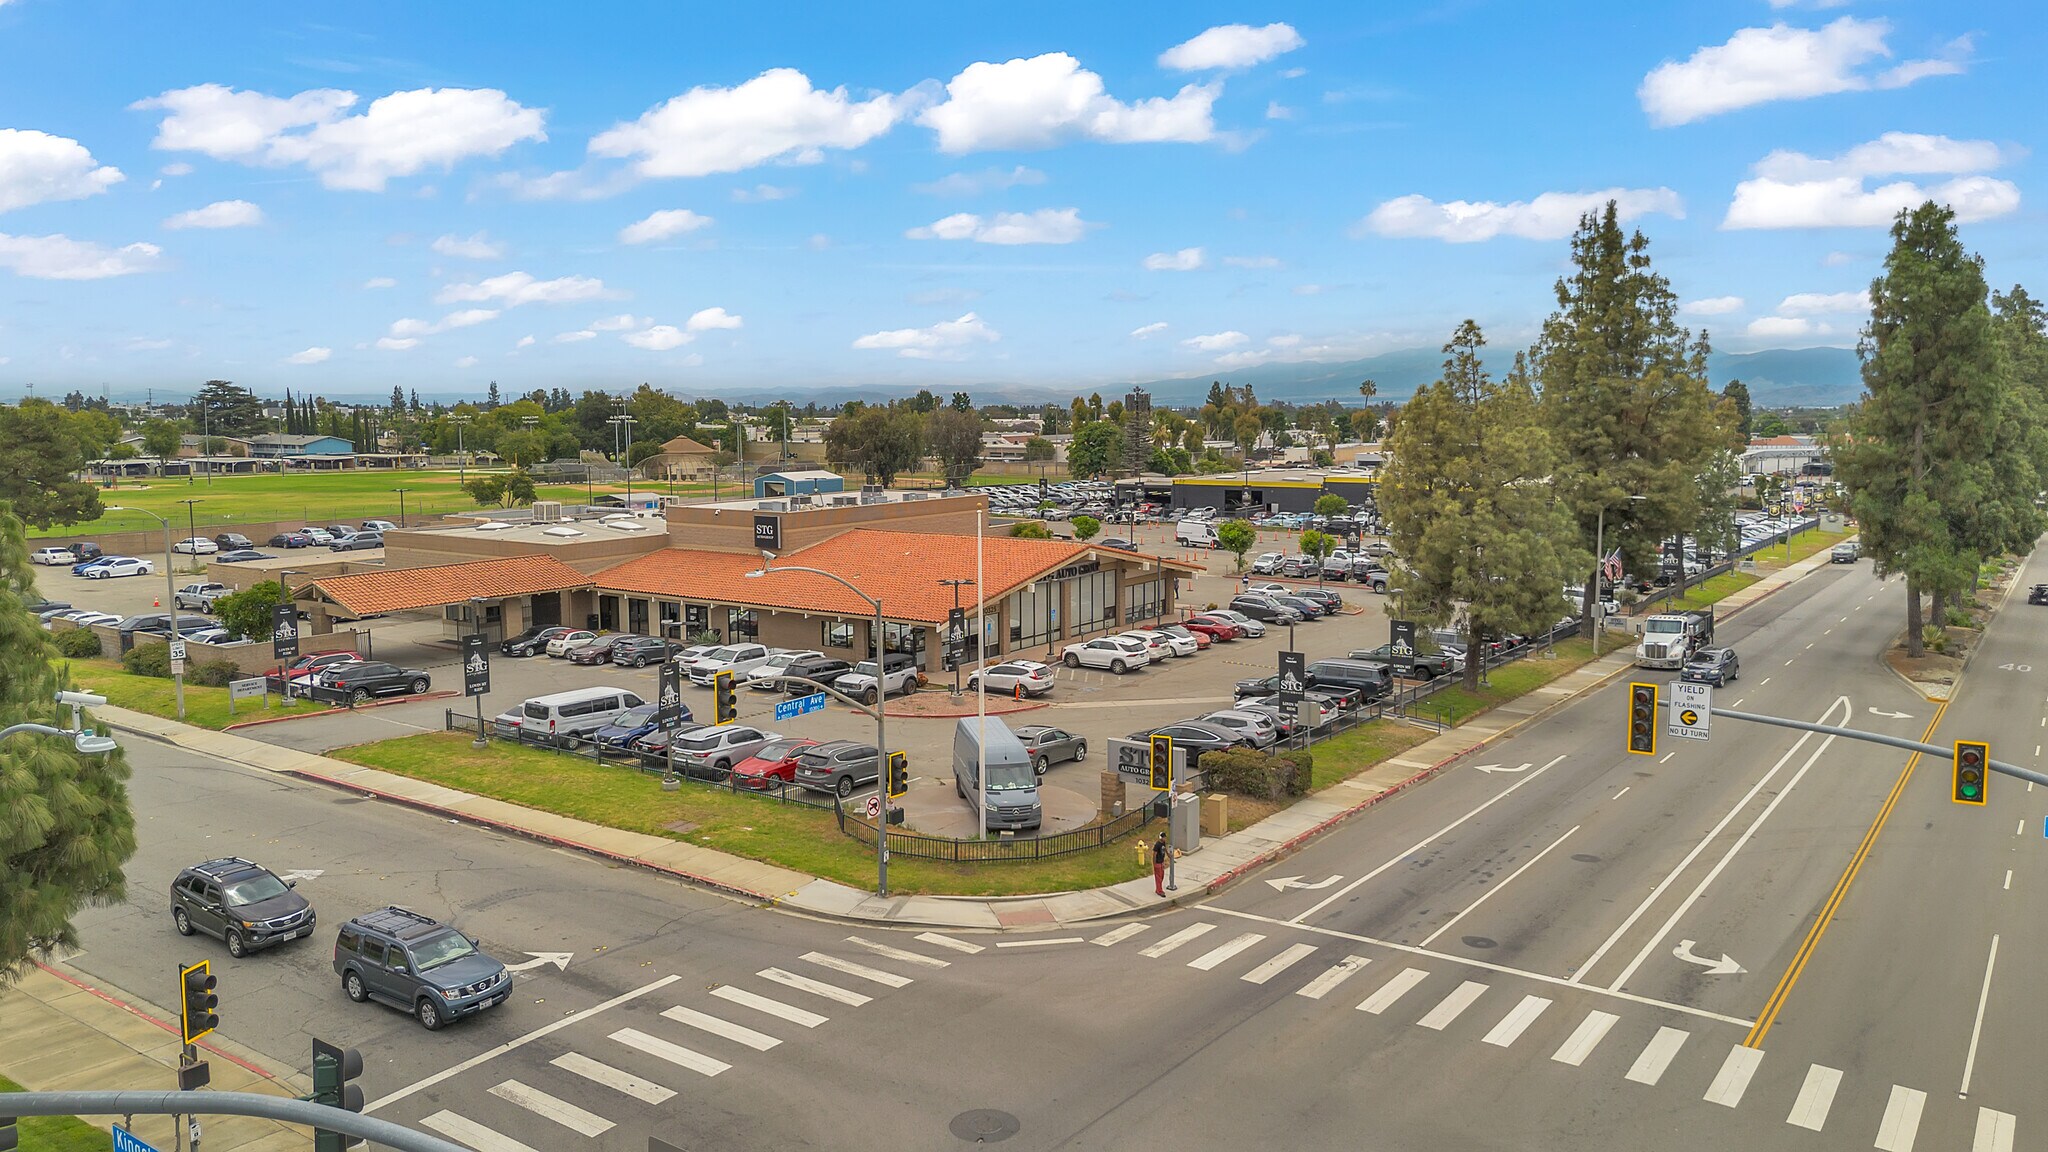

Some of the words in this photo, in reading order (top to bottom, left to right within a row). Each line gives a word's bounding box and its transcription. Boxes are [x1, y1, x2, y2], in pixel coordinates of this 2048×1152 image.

[756, 524, 773, 535] STG
[1664, 557, 1679, 565] STG
[1055, 567, 1077, 579] AUTO
[275, 627, 297, 639] STG
[950, 630, 964, 641] STG
[172, 650, 184, 658] 35
[1391, 645, 1413, 656] STG
[466, 660, 488, 673] STG
[1998, 663, 2032, 672] 40
[1280, 679, 1303, 692] STG
[1677, 684, 1705, 694] YIELD
[660, 692, 679, 707] STG
[777, 699, 805, 714] Central
[810, 695, 823, 705] Ave
[1674, 701, 1706, 710] FLASHING
[1681, 728, 1688, 736] U
[1690, 730, 1708, 738] TURN
[1119, 745, 1151, 766] ST
[1120, 765, 1139, 774] AUTO
[1135, 777, 1150, 785] 1032
